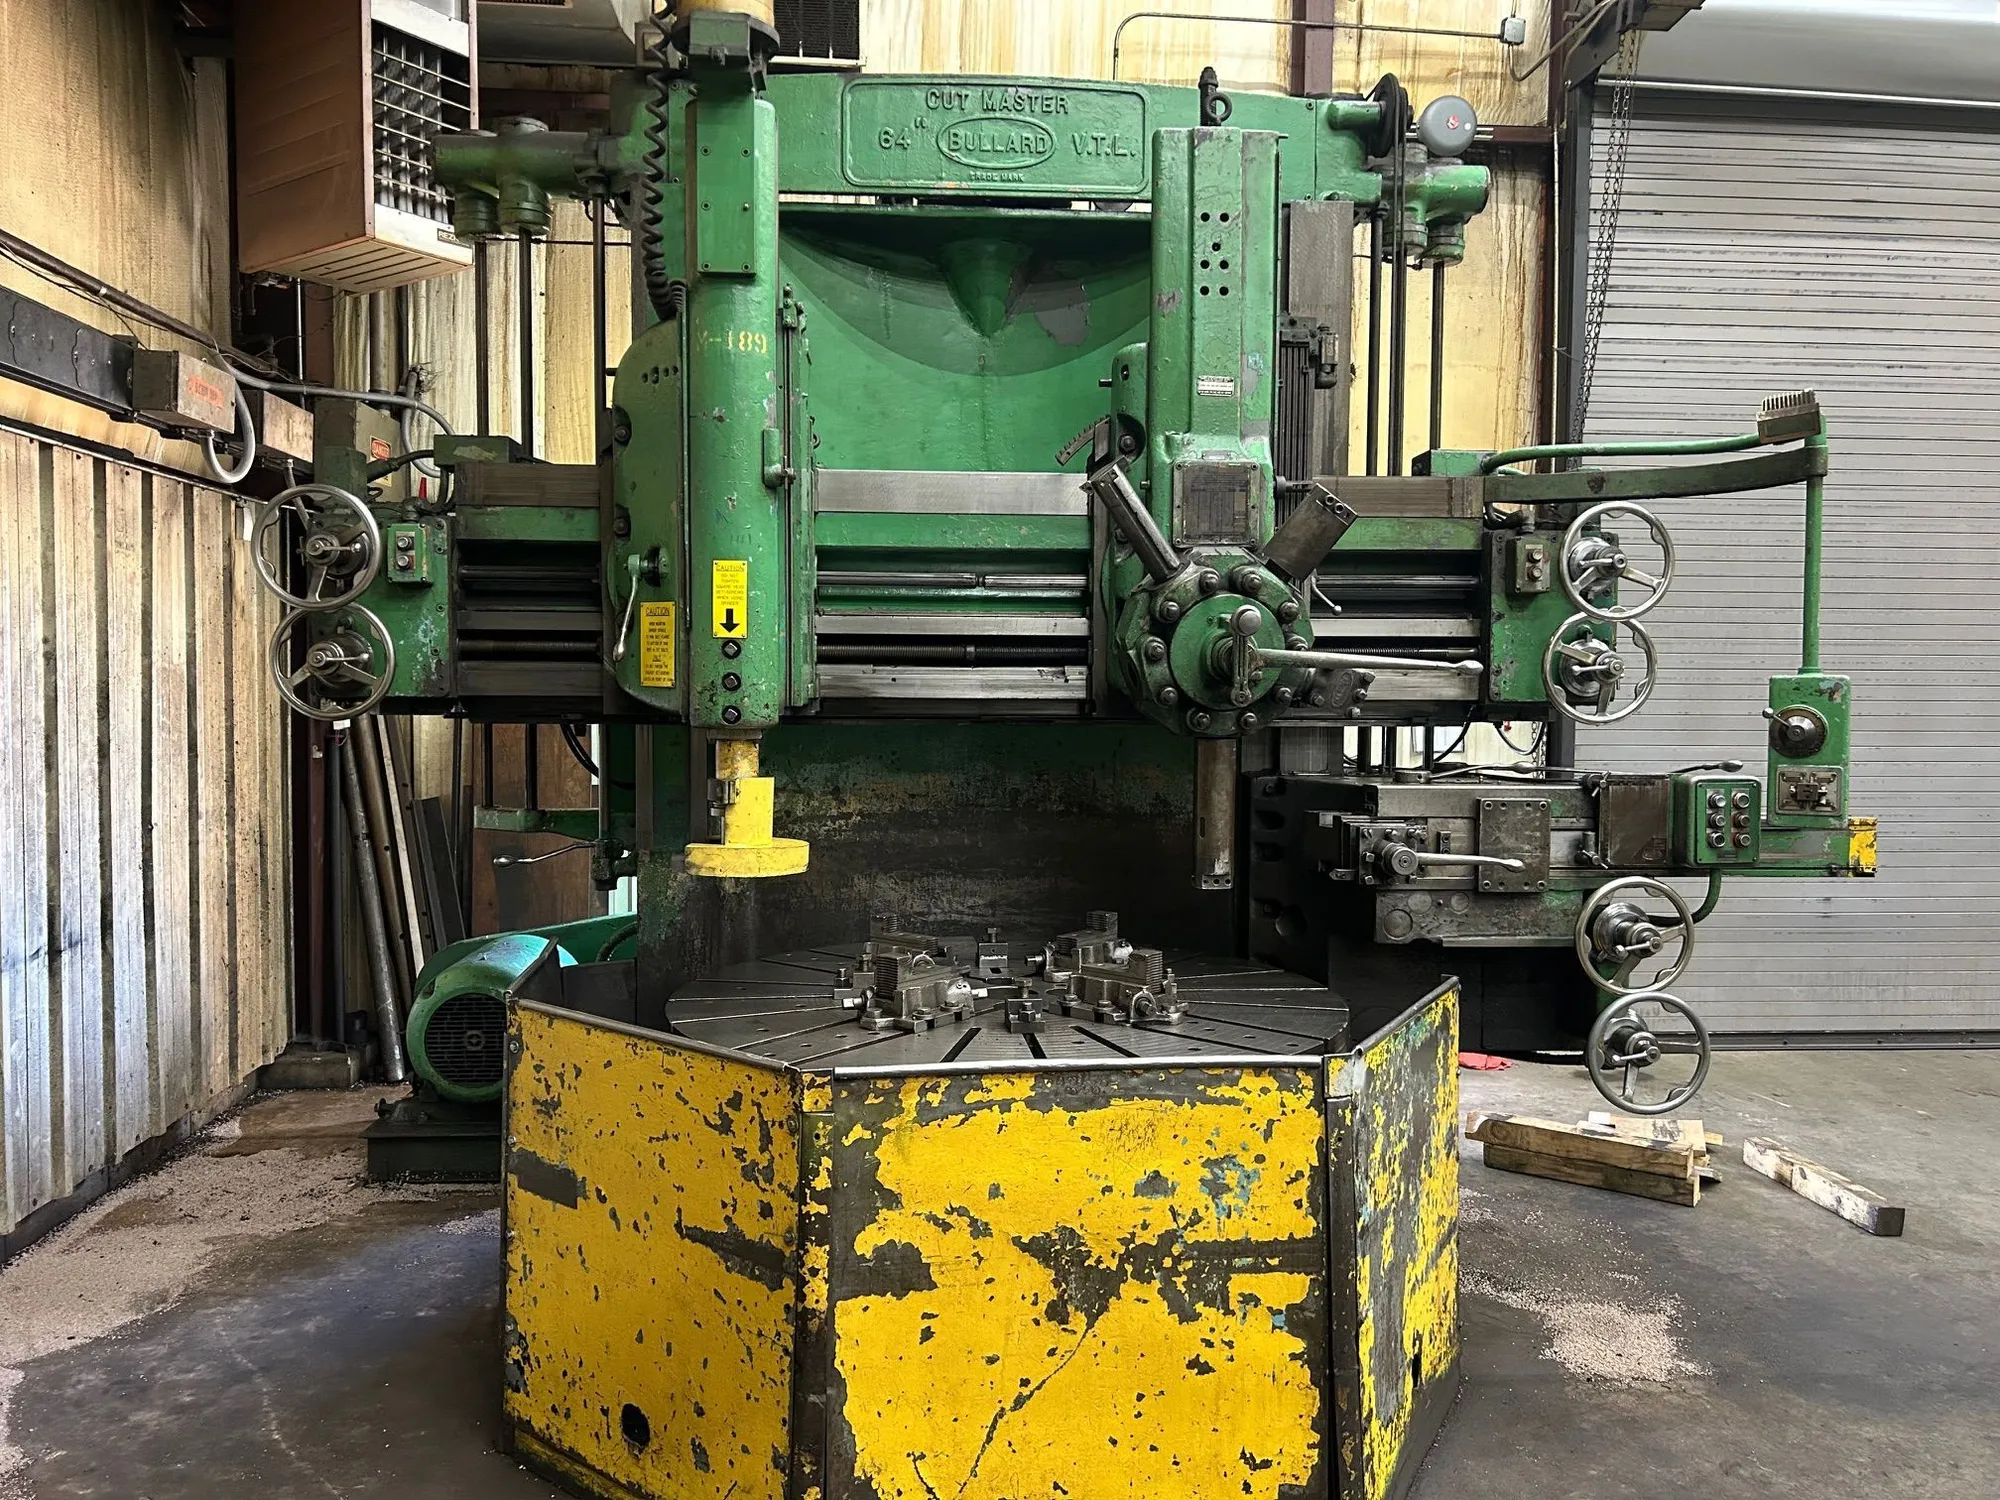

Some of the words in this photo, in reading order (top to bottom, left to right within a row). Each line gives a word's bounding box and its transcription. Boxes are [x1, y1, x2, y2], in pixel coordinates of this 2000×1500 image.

[926, 88, 971, 111] CUT
[981, 90, 1069, 115] MASTER
[947, 128, 1048, 154] BULLARD
[1071, 131, 1137, 157] V.T.L.
[969, 170, 999, 182] TRADE
[1001, 173, 1024, 183] MARK
[716, 564, 745, 572] CAUTION
[646, 606, 670, 617] CAUTION
